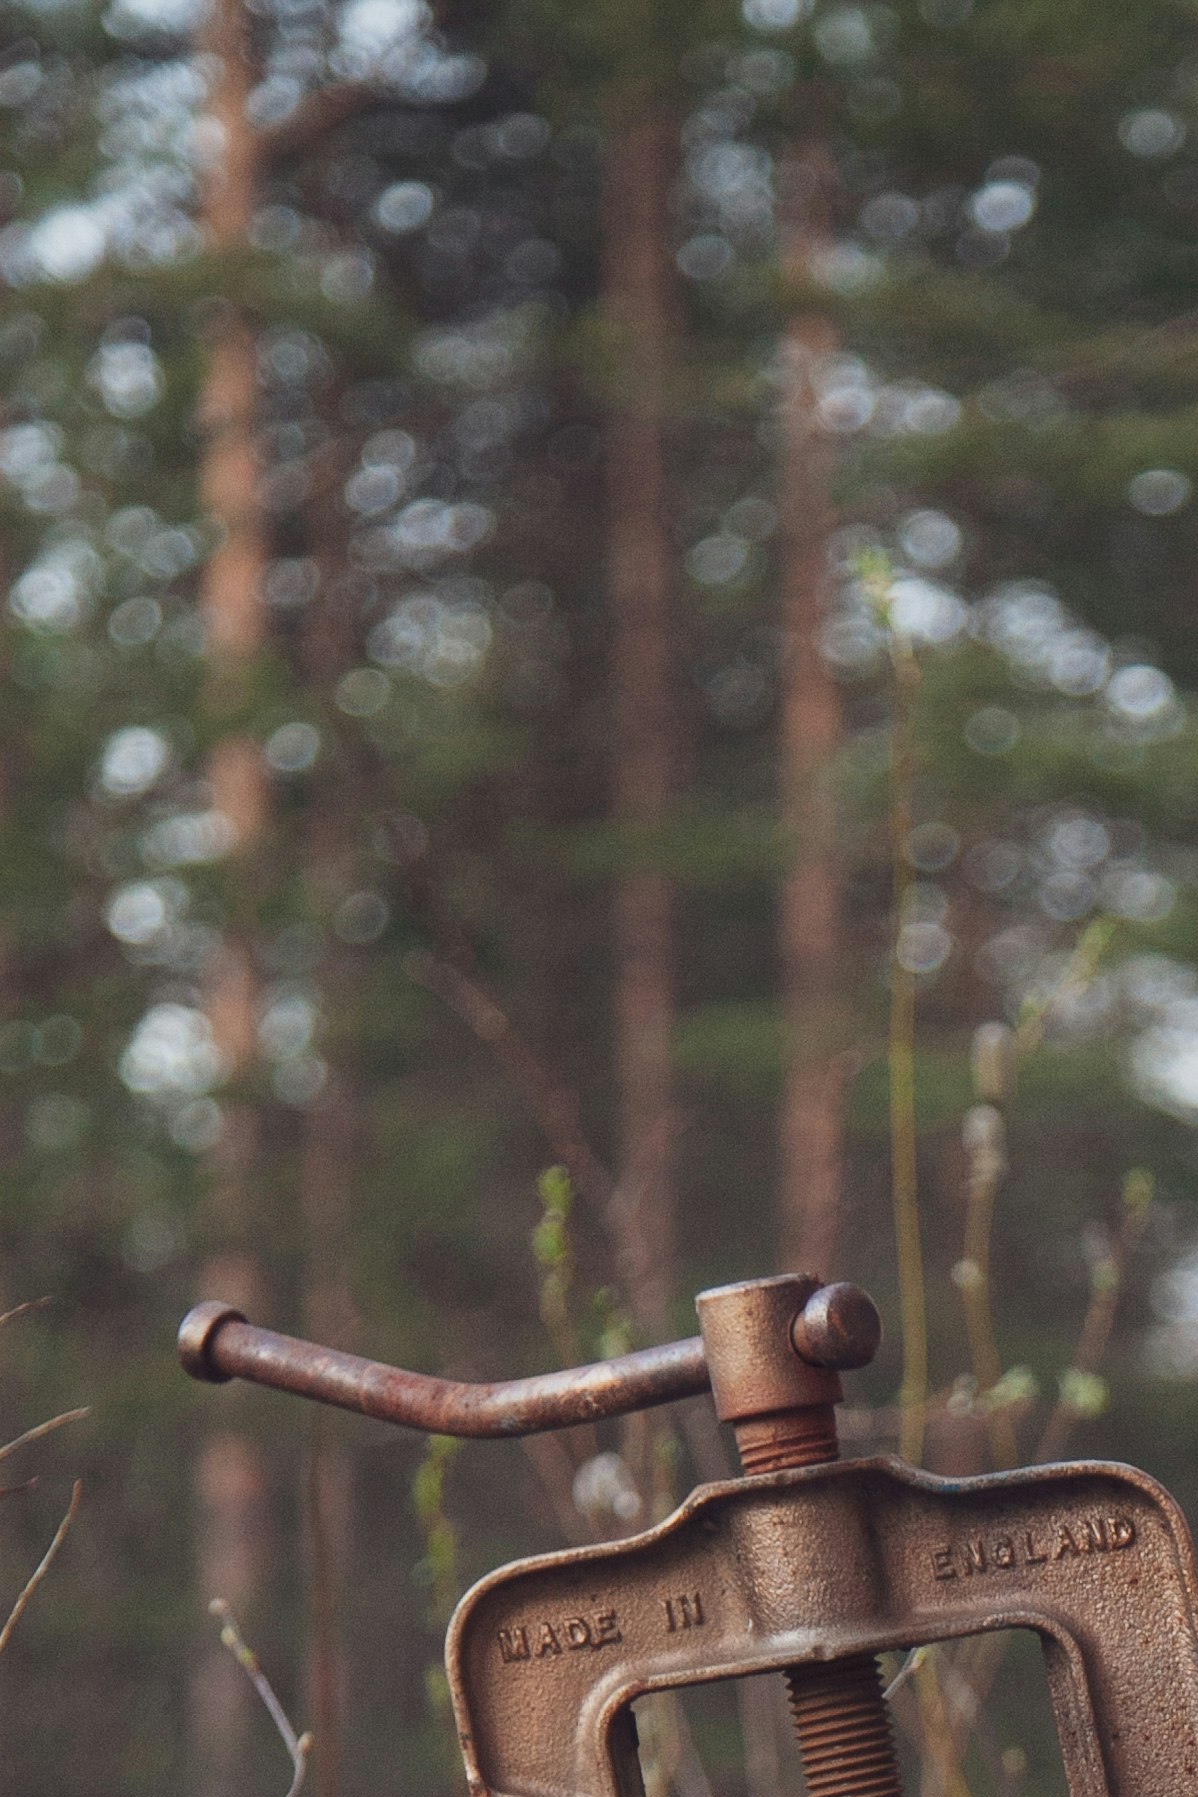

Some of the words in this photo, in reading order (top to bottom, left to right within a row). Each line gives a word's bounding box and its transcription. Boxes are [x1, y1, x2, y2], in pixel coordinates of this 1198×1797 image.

[498, 1609, 623, 1664] MADE
[660, 1592, 705, 1632] IN
[930, 1517, 1136, 1581] ENGLAND
